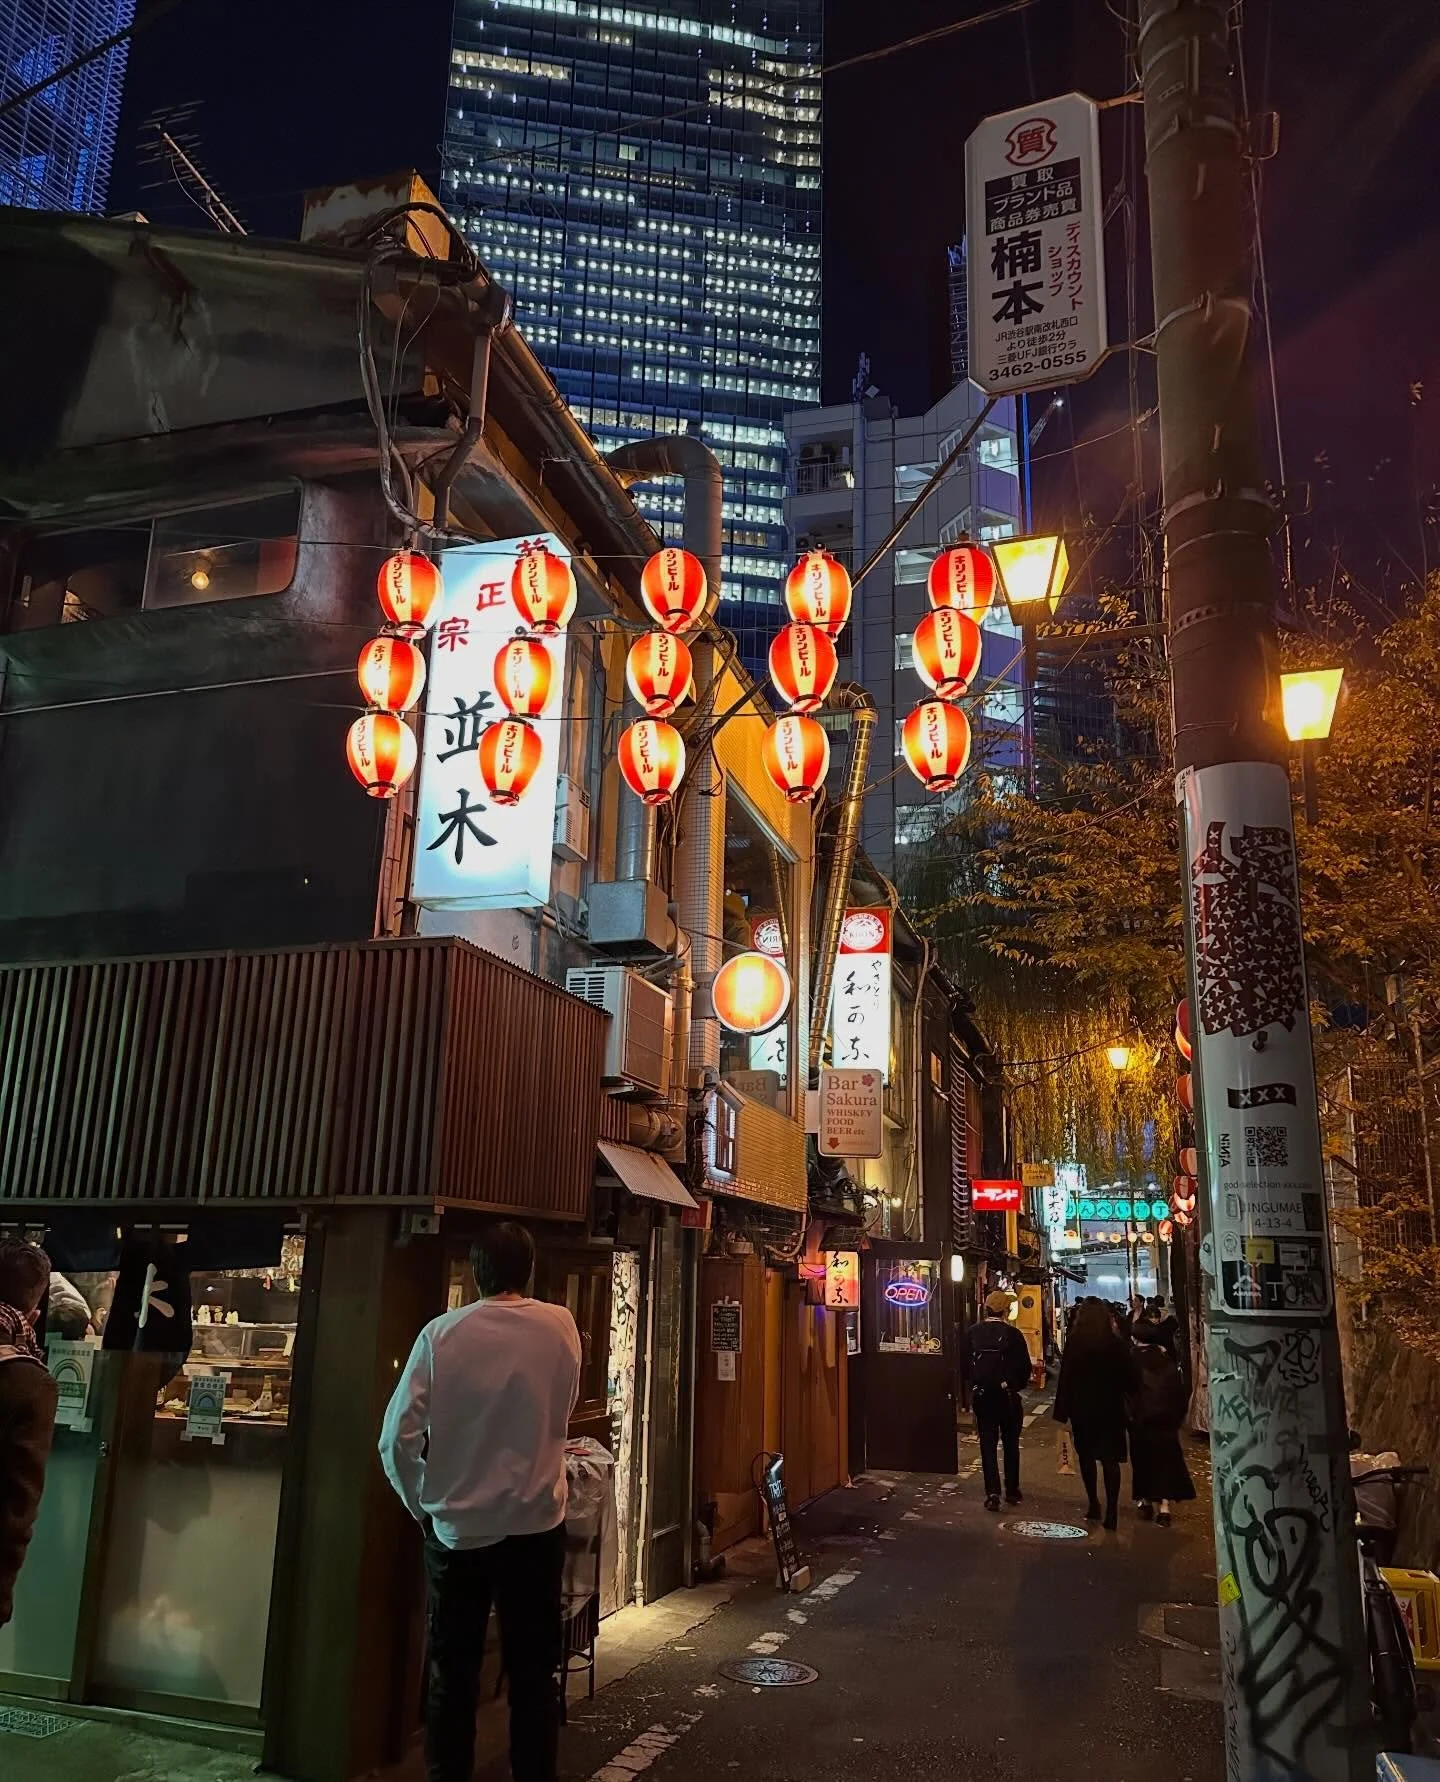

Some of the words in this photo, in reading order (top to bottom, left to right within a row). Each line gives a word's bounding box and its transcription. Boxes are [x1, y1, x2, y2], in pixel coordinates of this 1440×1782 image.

[1016, 126, 1045, 160] 質
[994, 181, 1074, 213] ブランド品
[1011, 165, 1054, 191] 買取
[990, 198, 1079, 233] 商品券売買
[990, 229, 1045, 326] 楠本
[1048, 246, 1065, 298] ショップ
[1065, 221, 1084, 311] ディスカウント
[997, 339, 1078, 366] 三菱UFJ銀行ウラ
[1006, 329, 1067, 352] より徒歩2分
[988, 350, 1088, 382] 3462-0555
[392, 556, 406, 606] キリンビール
[527, 556, 543, 605] キリンビール
[810, 563, 827, 618] キリンビール
[795, 625, 812, 678] キリンビール
[940, 611, 957, 660] キリンビール
[356, 718, 372, 768] キリンビール
[500, 723, 519, 774] キリンビール
[637, 725, 654, 775] キリンビール
[781, 719, 799, 771] キリンビール
[926, 707, 942, 759] キリンビール
[426, 690, 499, 867] 並木
[826, 1092, 878, 1106] Sakura
[827, 1075, 860, 1091] Bar
[826, 1108, 873, 1118] WHISKEY
[826, 1117, 855, 1126] FOOD
[826, 1126, 852, 1135] BEER
[1254, 1217, 1293, 1229] 4-13-4
[884, 1286, 928, 1302] OPEN
